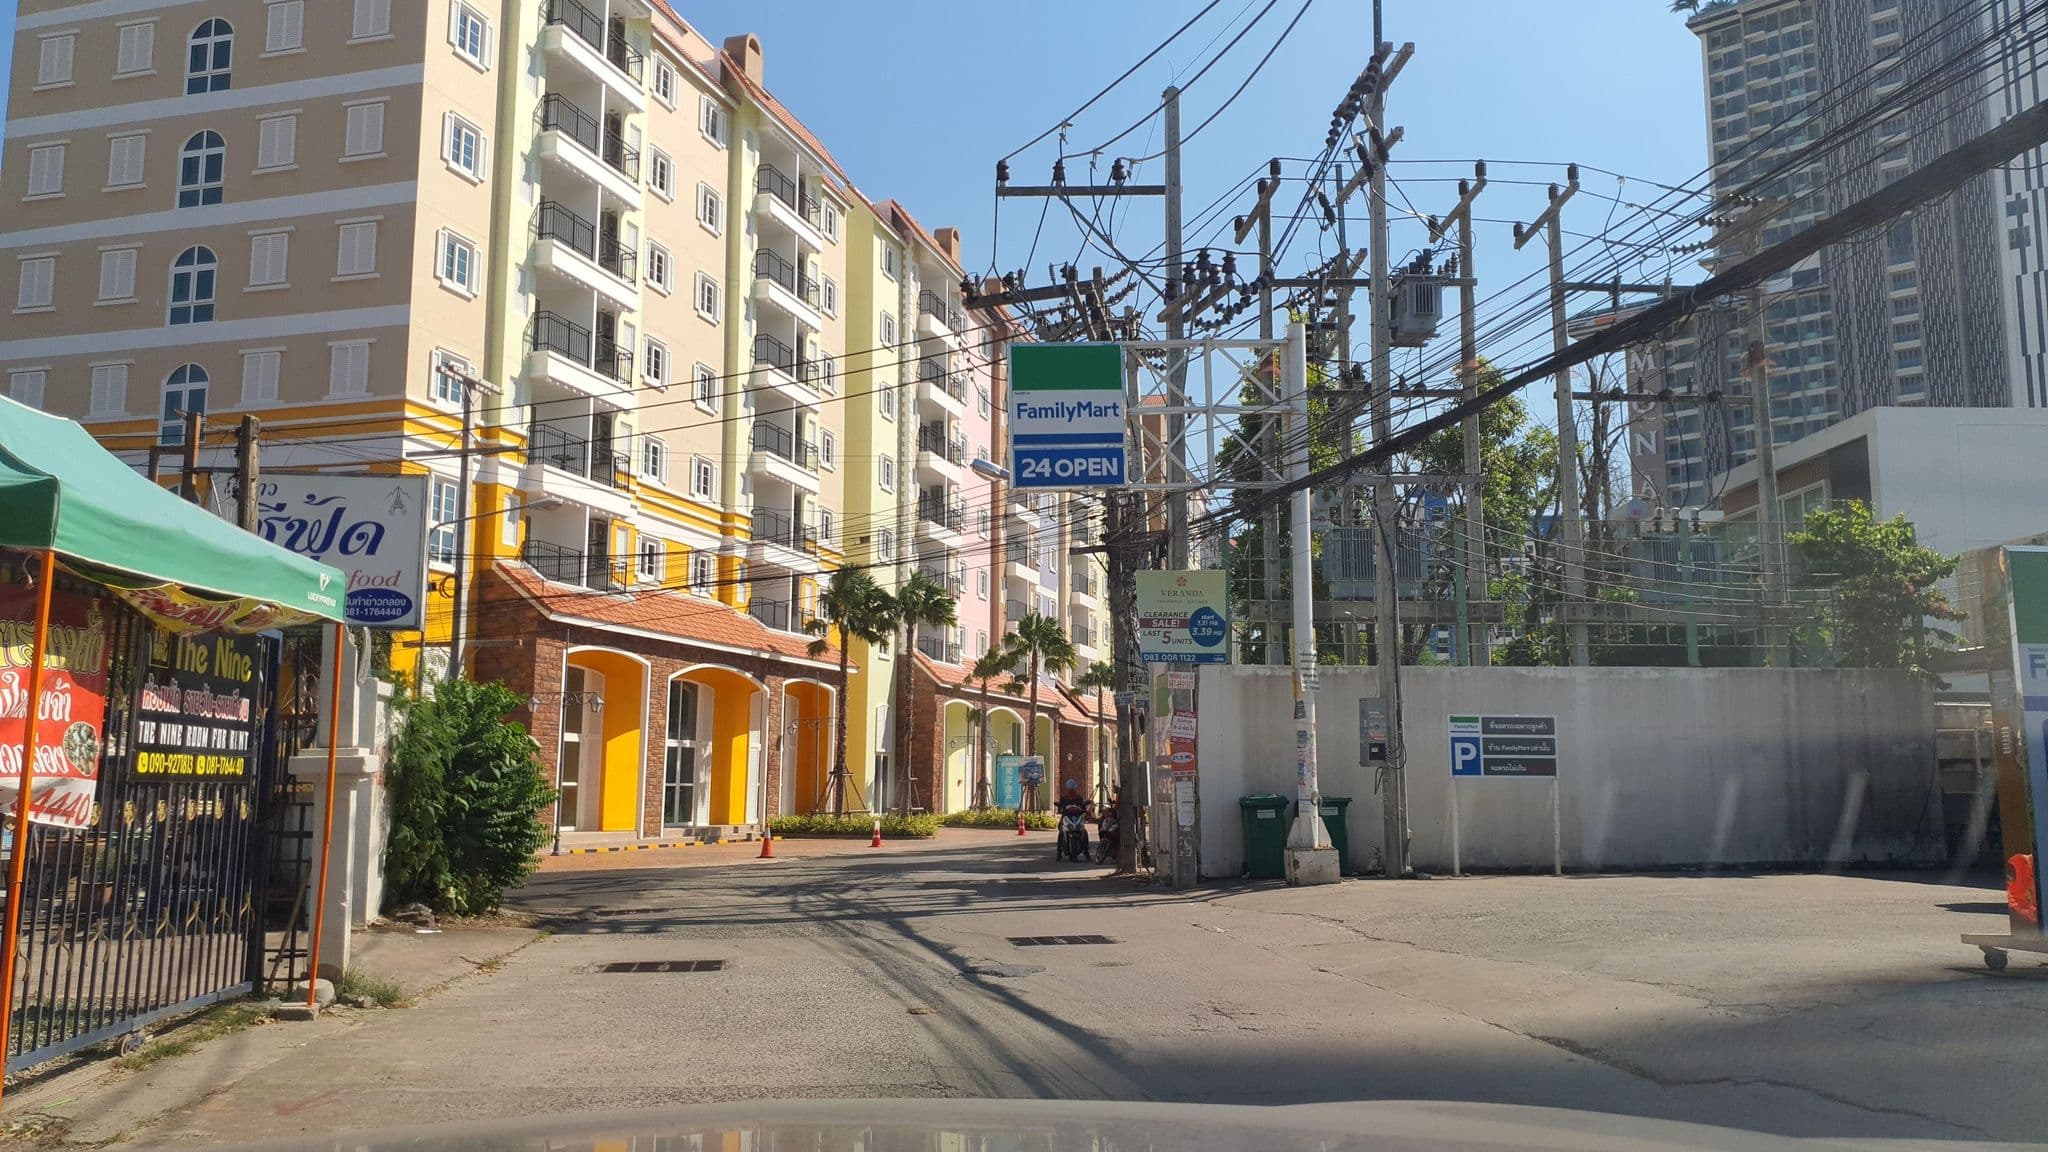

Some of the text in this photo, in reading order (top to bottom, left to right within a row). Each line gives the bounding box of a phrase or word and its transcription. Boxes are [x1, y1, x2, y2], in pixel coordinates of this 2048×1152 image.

[1016, 401, 1120, 423] FamilyMart
[1021, 457, 1119, 479] 24 OPEN
[1160, 589, 1205, 597] VERANDA
[1151, 619, 1180, 628] SALE!
[1161, 631, 1172, 645] 5
[176, 634, 252, 682] The Nine
[138, 720, 156, 744] THE
[159, 722, 183, 747] NINE
[185, 725, 210, 748] ROOM
[211, 728, 227, 749] FOR
[1454, 742, 1477, 770] P
